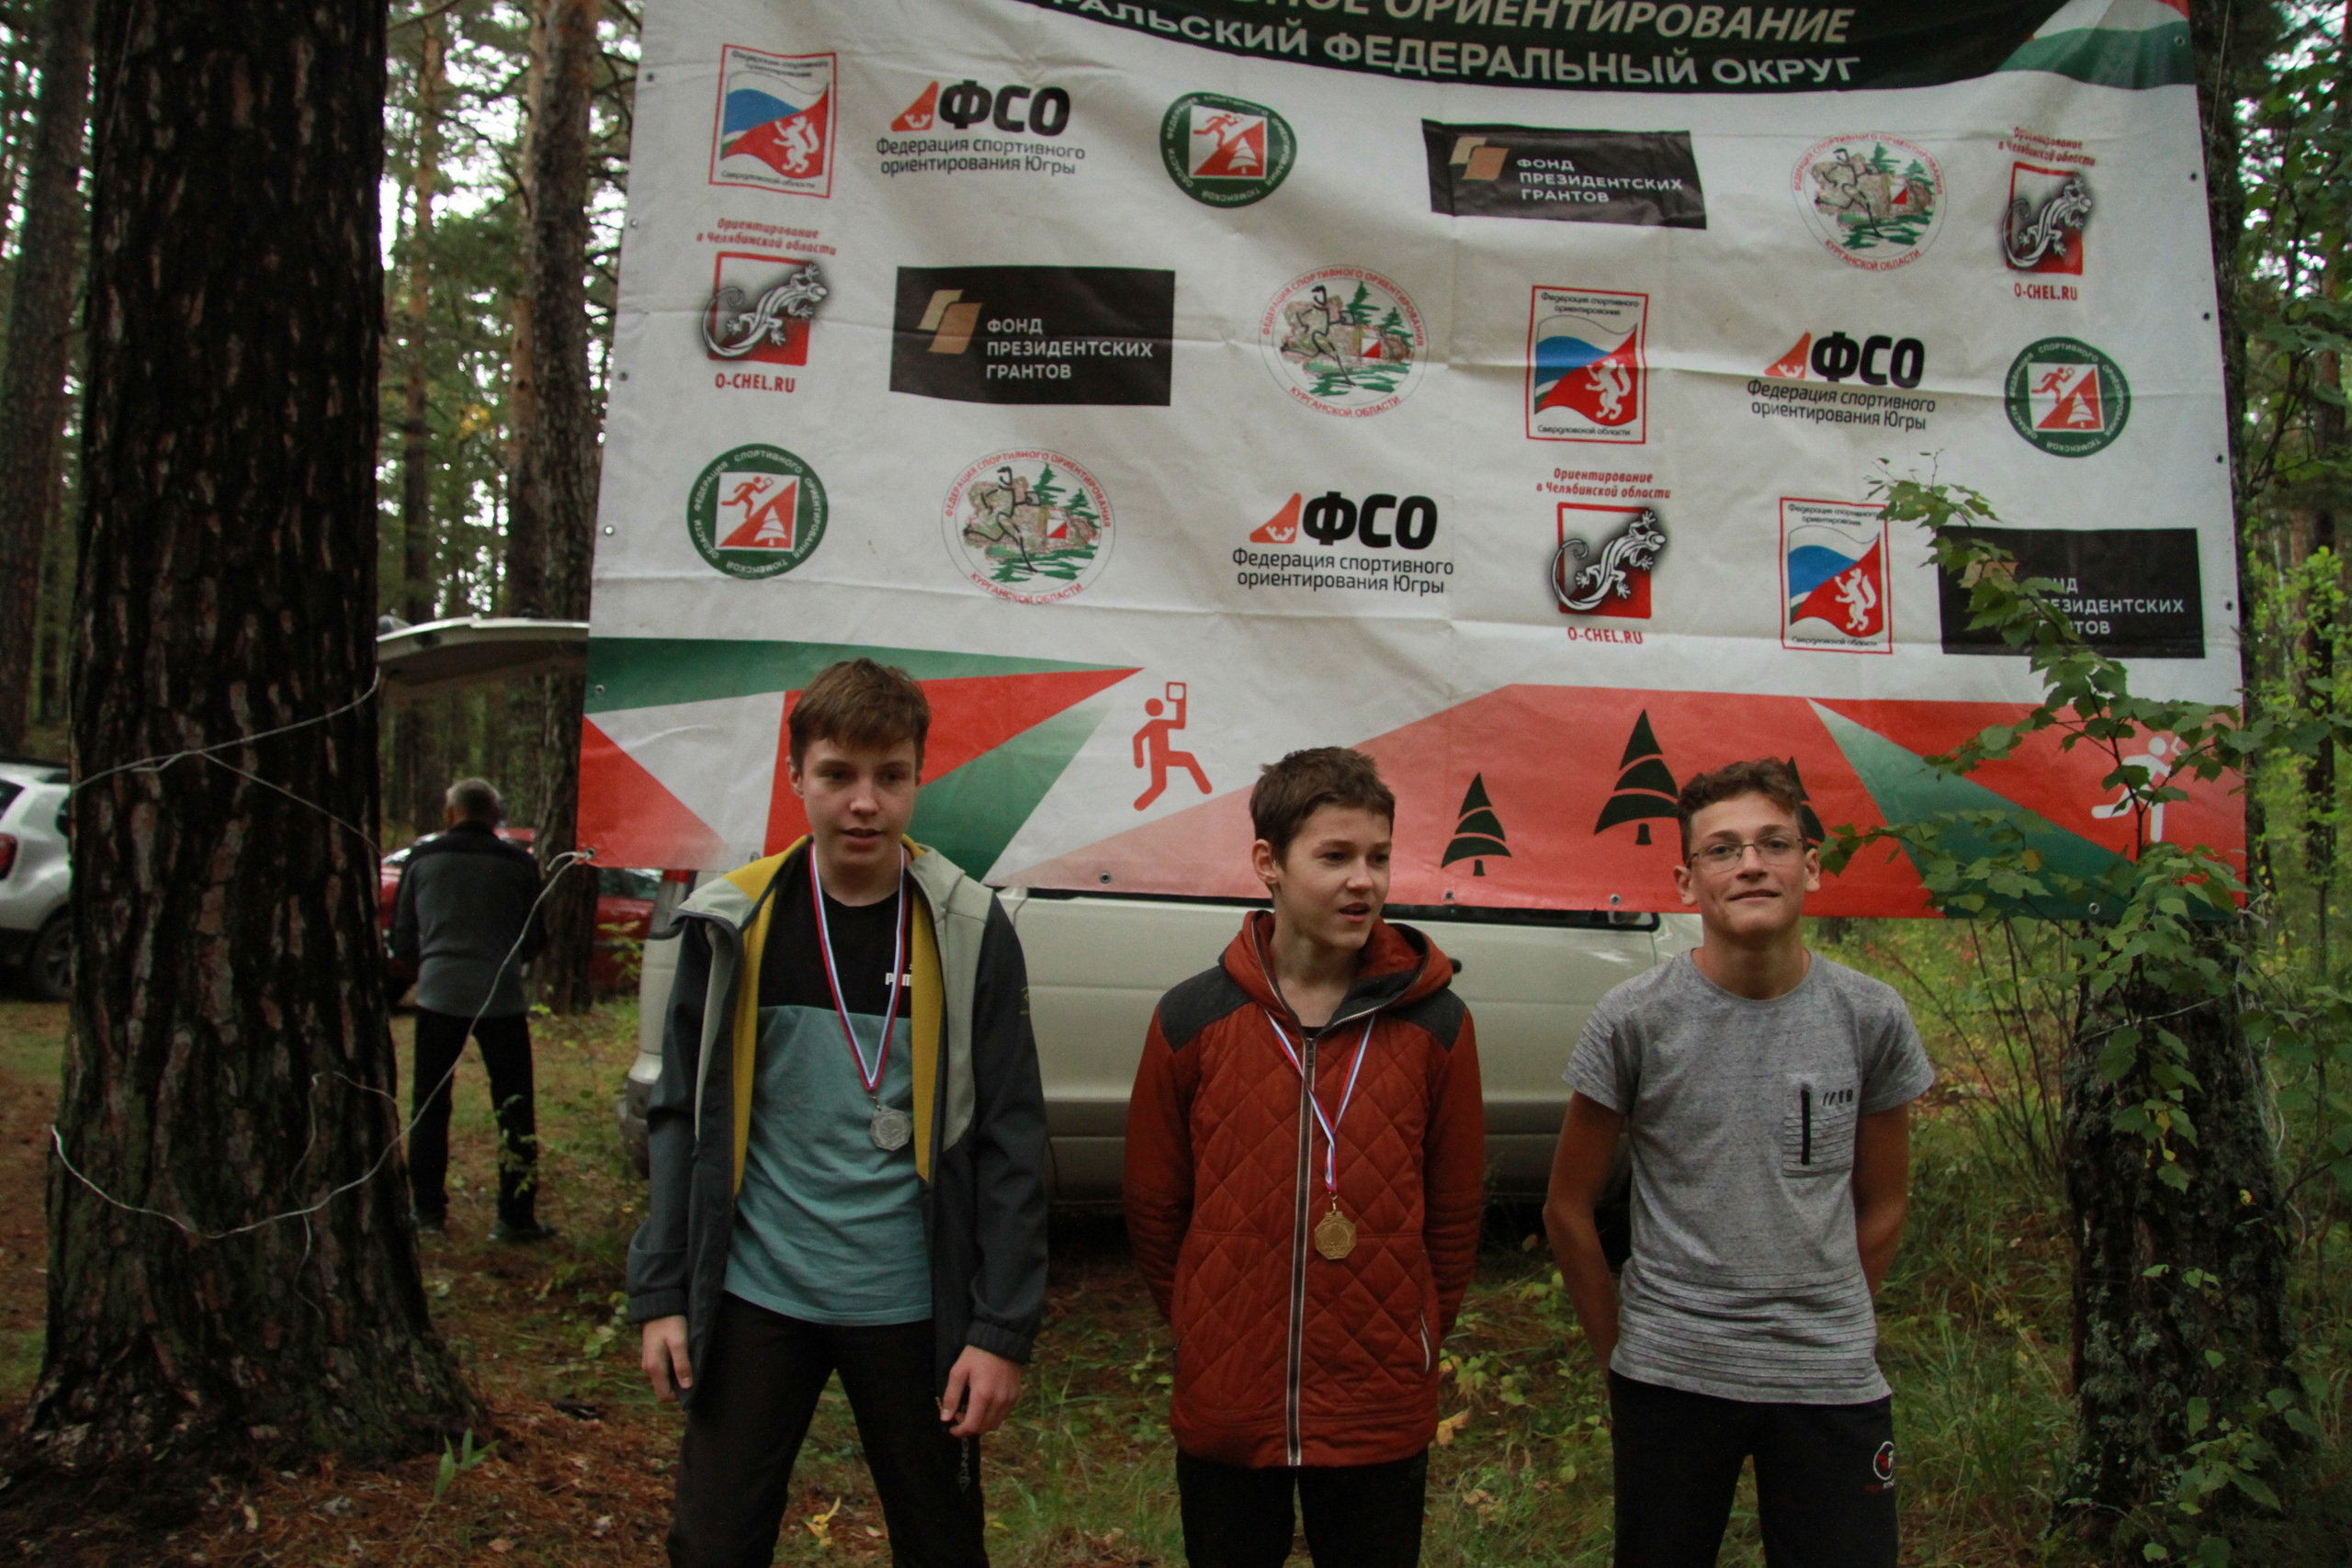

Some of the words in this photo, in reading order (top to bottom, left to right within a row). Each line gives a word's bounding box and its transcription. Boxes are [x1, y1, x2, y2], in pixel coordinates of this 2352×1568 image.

[1053, 0, 1307, 56] АЛЬСКИЙ
[1323, 31, 1698, 85] ФЕДЕРАЛЬНЫЙ
[1713, 56, 1860, 85] ОКРУГ
[939, 79, 1070, 136] ФСО
[876, 137, 968, 157] Федерация
[973, 139, 1085, 160] спортивного
[881, 156, 1020, 177] ориентирования
[1025, 155, 1075, 176] Югры
[1517, 159, 1575, 172] ФОНД
[1520, 172, 1682, 190] ПРЕЗИДЕНТСКИХ
[1521, 189, 1609, 203] ГРАНТОВ
[2014, 283, 2077, 300] O-CHEL.RU
[987, 319, 1043, 334] ФОНД
[987, 341, 1153, 358] ПРЕЗИДЕНТСКИХ
[1811, 332, 1925, 389] ФСО
[986, 365, 1071, 378] ГРАНТОВ
[715, 373, 796, 392] O-CHEL.RU
[1747, 379, 1837, 404] Федерация
[1840, 391, 1935, 412] спортивного
[1751, 401, 1880, 425] ориентирования
[1884, 411, 1926, 432] Югры
[1554, 468, 1653, 484] Ориентирование
[1546, 482, 1618, 497] Челябинской
[1622, 486, 1671, 499] области
[1302, 491, 1438, 549] ФСО
[1233, 547, 1334, 570] Федерация
[1340, 557, 1453, 575] спортивного
[1238, 571, 1387, 591] ориентирования
[1394, 575, 1444, 596] Югры
[2037, 599, 2184, 615] ЕЗИДЕНТСКИХ
[1567, 626, 1643, 644] O-CHEL.RU
